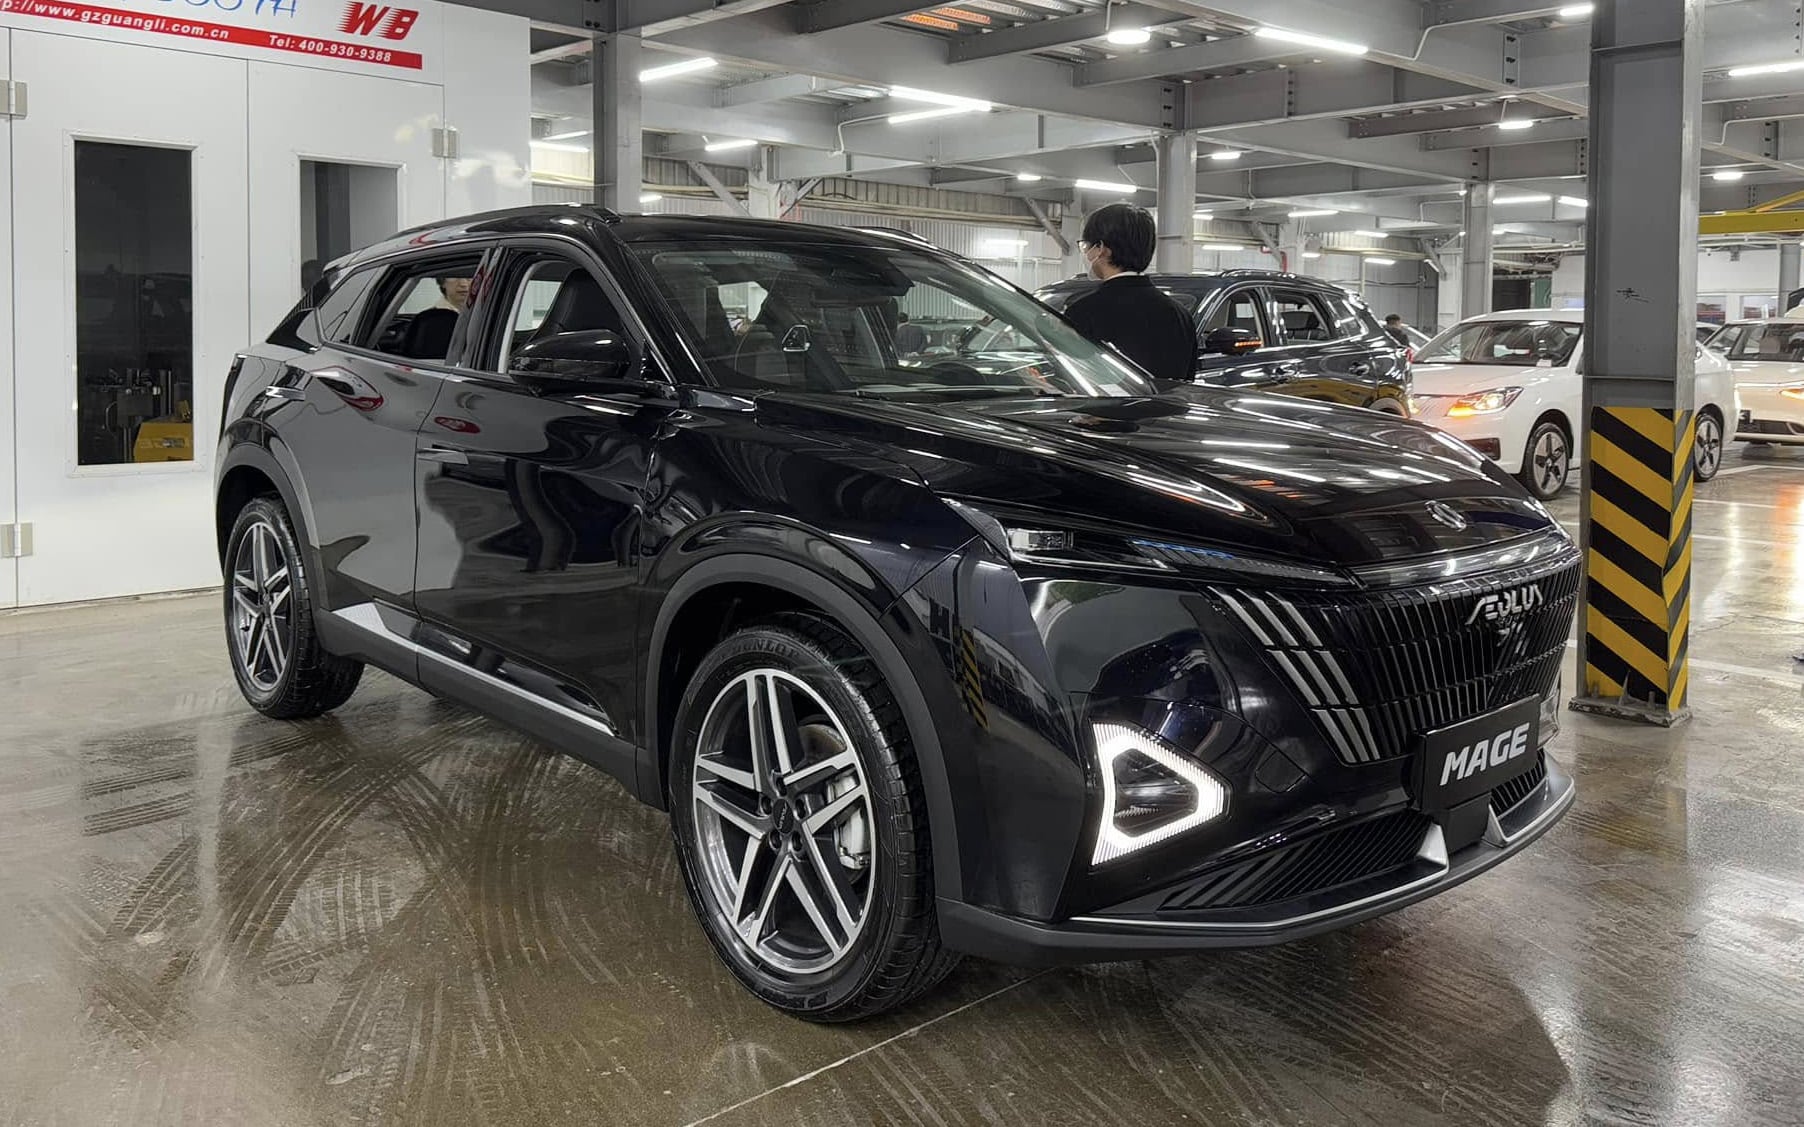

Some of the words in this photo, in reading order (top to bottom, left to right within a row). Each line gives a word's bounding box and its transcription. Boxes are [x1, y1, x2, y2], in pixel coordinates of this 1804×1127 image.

[336, 1, 419, 40] WB
[269, 34, 296, 49] Tel:
[299, 39, 392, 62] 400-930-9388
[1440, 722, 1530, 786] MAGE
